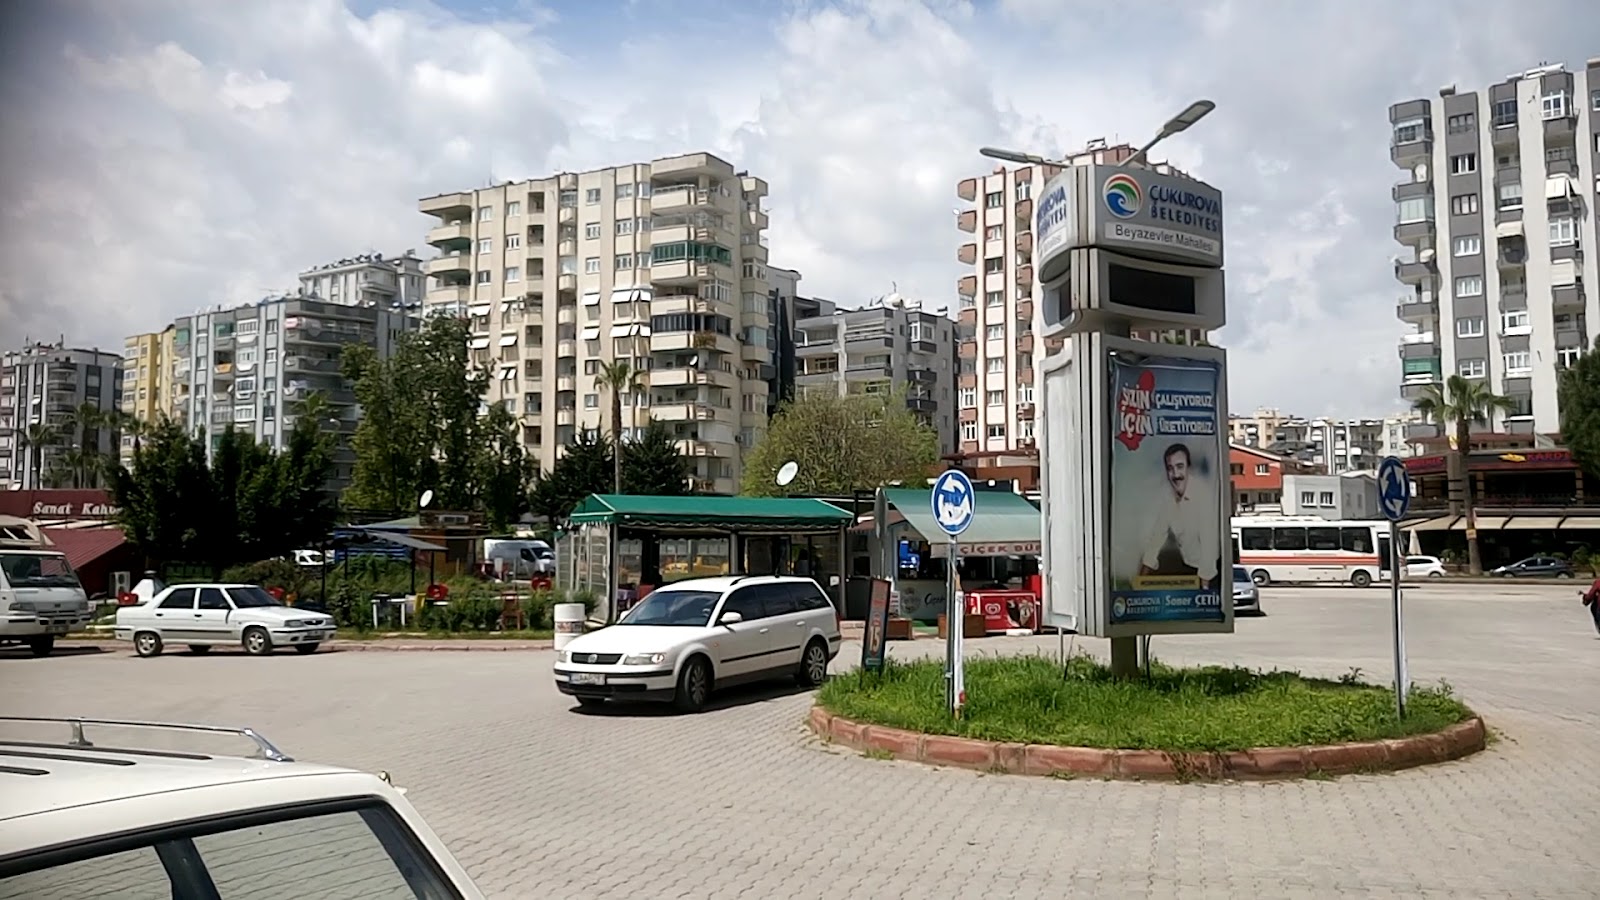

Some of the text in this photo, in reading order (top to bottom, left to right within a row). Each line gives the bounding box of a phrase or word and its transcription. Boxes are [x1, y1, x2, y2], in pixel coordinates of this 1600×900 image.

[1149, 185, 1220, 216] ÇUKUROVA
[1115, 224, 1213, 252] Beyazevler Mahallesi
[1155, 394, 1214, 410] ÇALIŞIYORUZ
[1120, 406, 1154, 439] İÇİN
[1159, 417, 1214, 433] ÜRETİYORUZ
[33, 502, 73, 515] Sanat
[960, 544, 1008, 555] ÇİÇEK
[1165, 595, 1192, 606] Soner
